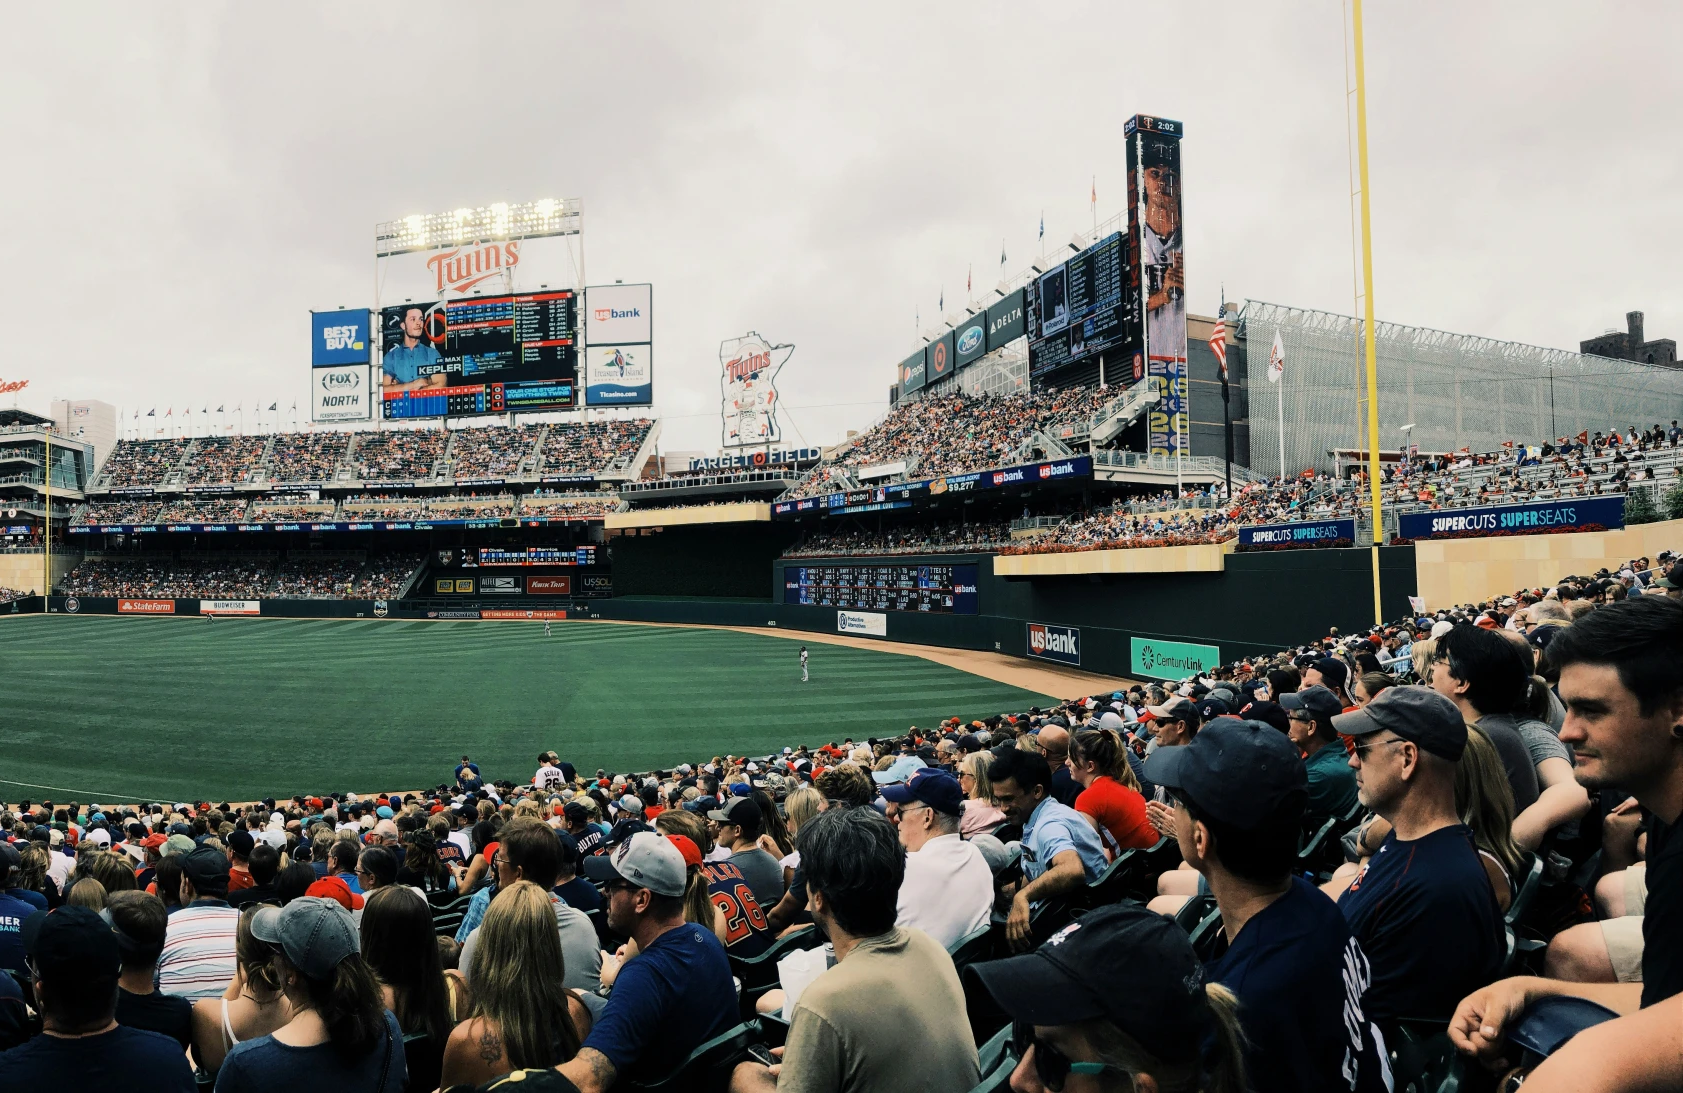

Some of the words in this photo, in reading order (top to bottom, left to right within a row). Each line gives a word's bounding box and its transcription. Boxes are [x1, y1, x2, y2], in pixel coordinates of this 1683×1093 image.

[1124, 120, 1136, 132] 2:02
[1158, 122, 1174, 132] 2:02
[1128, 169, 1138, 287] KEPLER
[426, 240, 519, 292] Twins
[997, 310, 1022, 330] DELTA
[1028, 282, 1036, 342] KEPLER
[324, 326, 358, 338] BEST
[326, 337, 355, 350] BUY
[962, 333, 978, 350] Ford
[418, 364, 462, 375] KEPLER
[594, 368, 618, 378] Treasure
[625, 367, 644, 376] Island
[726, 351, 770, 384] Twins
[1134, 354, 1140, 382] 26
[330, 373, 351, 384] FOX
[322, 395, 359, 407] NORTH
[1151, 412, 1188, 433] 26
[1151, 434, 1188, 447] 26
[688, 455, 750, 471] TARGET
[770, 447, 821, 463] FIELD
[902, 490, 910, 498] 1B
[948, 482, 974, 492] $9,277
[1432, 514, 1496, 532] SUPERCUTS
[1500, 508, 1576, 528] SUPERSEATS
[1252, 528, 1292, 542] SUPERCUTS
[1293, 526, 1338, 540] SUPERSEATS
[482, 578, 496, 586] ALTEC
[1156, 653, 1202, 672] CenturyLink
[437, 847, 460, 860] CRUZ
[702, 863, 745, 886] PLER
[708, 884, 768, 948] 26
